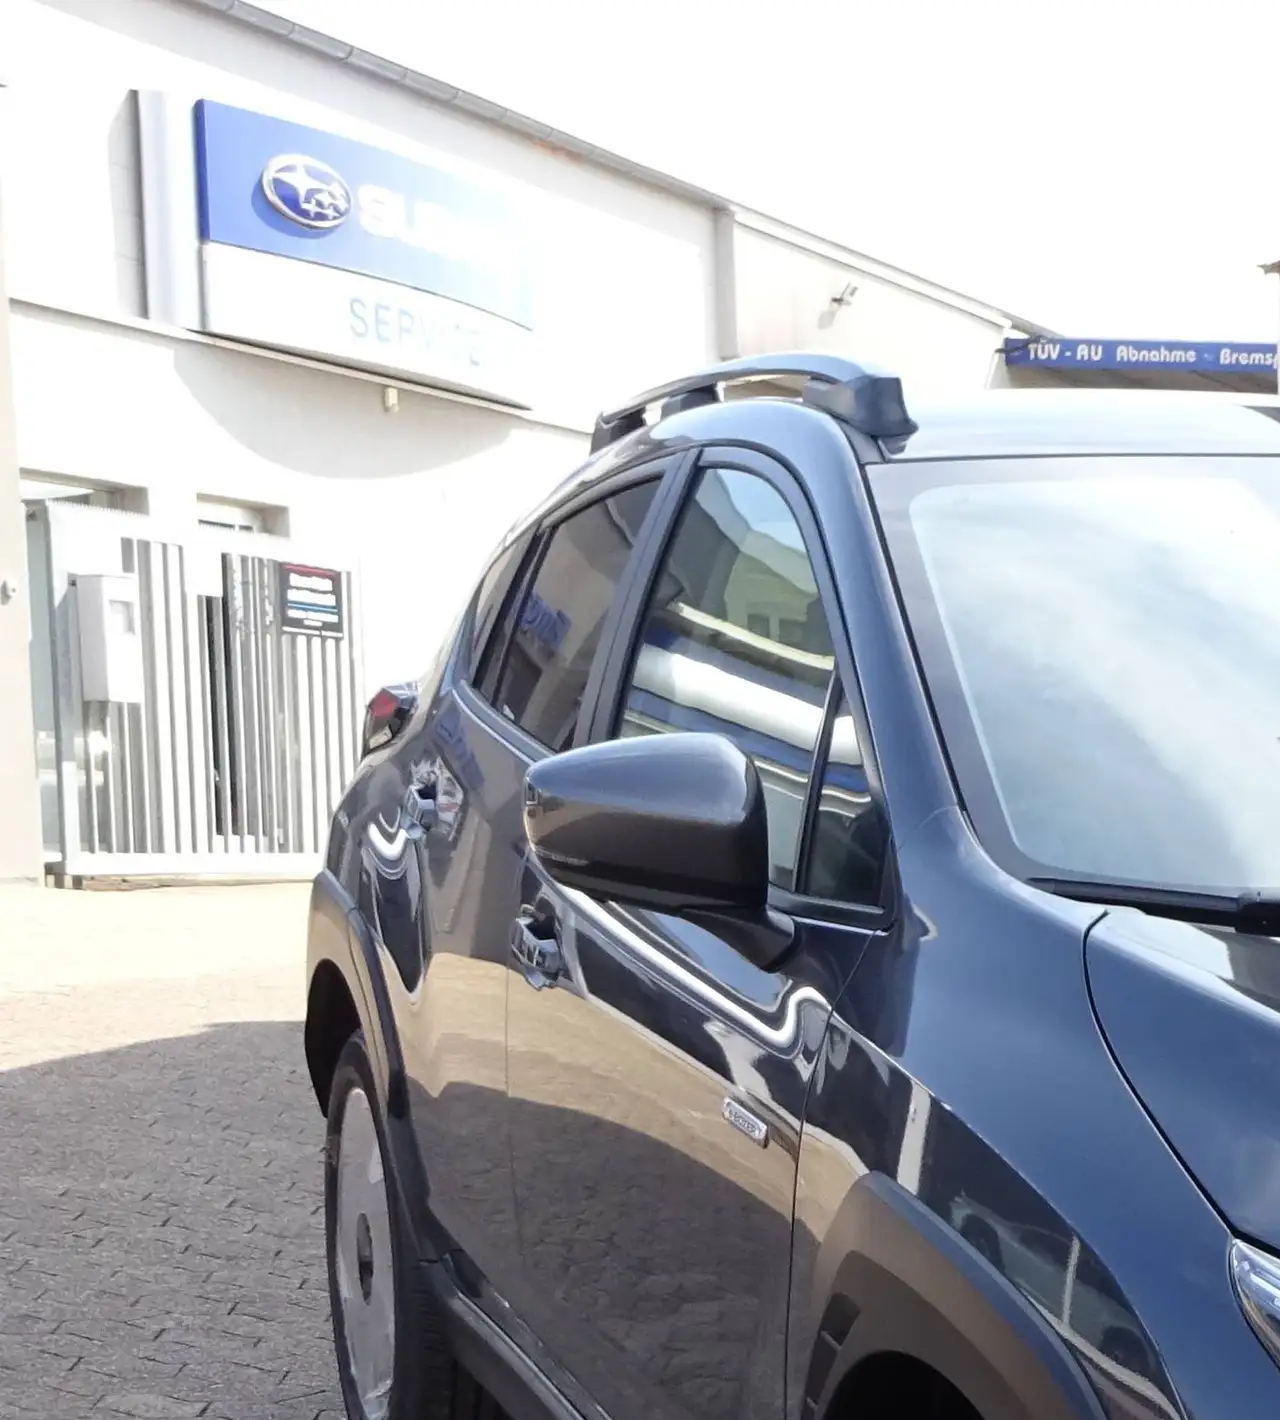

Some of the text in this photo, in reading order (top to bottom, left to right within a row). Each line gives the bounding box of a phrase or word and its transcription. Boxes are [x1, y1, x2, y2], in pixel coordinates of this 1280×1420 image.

[1027, 339, 1060, 361] TÜV
[1076, 343, 1103, 361] AU
[1116, 345, 1197, 363] Abnahme
